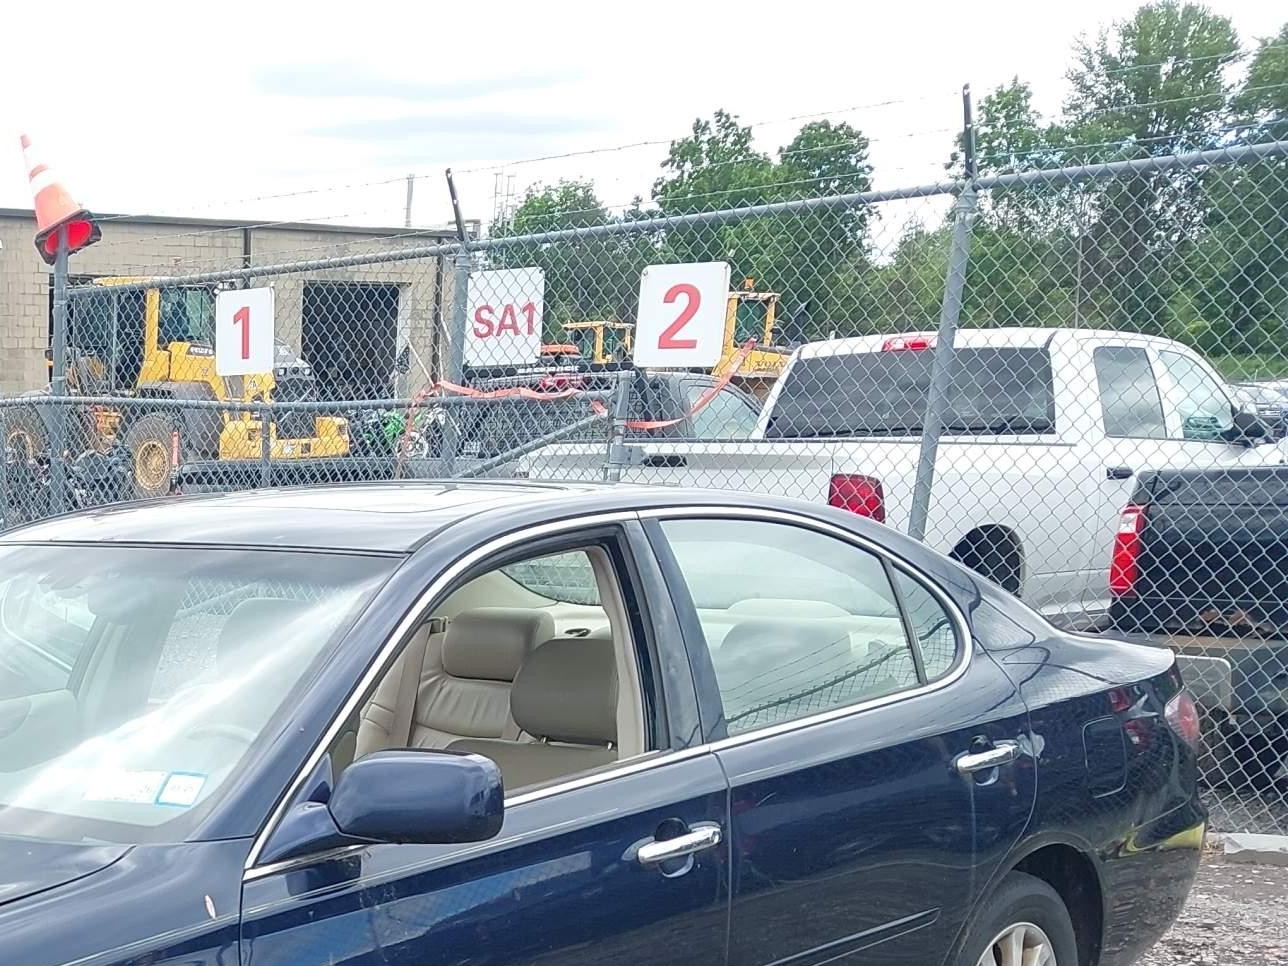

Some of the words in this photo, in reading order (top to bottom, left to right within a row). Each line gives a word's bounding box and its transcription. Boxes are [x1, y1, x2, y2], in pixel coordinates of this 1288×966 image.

[232, 306, 250, 360] 1
[473, 302, 537, 338] SA1
[657, 283, 701, 349] 2
